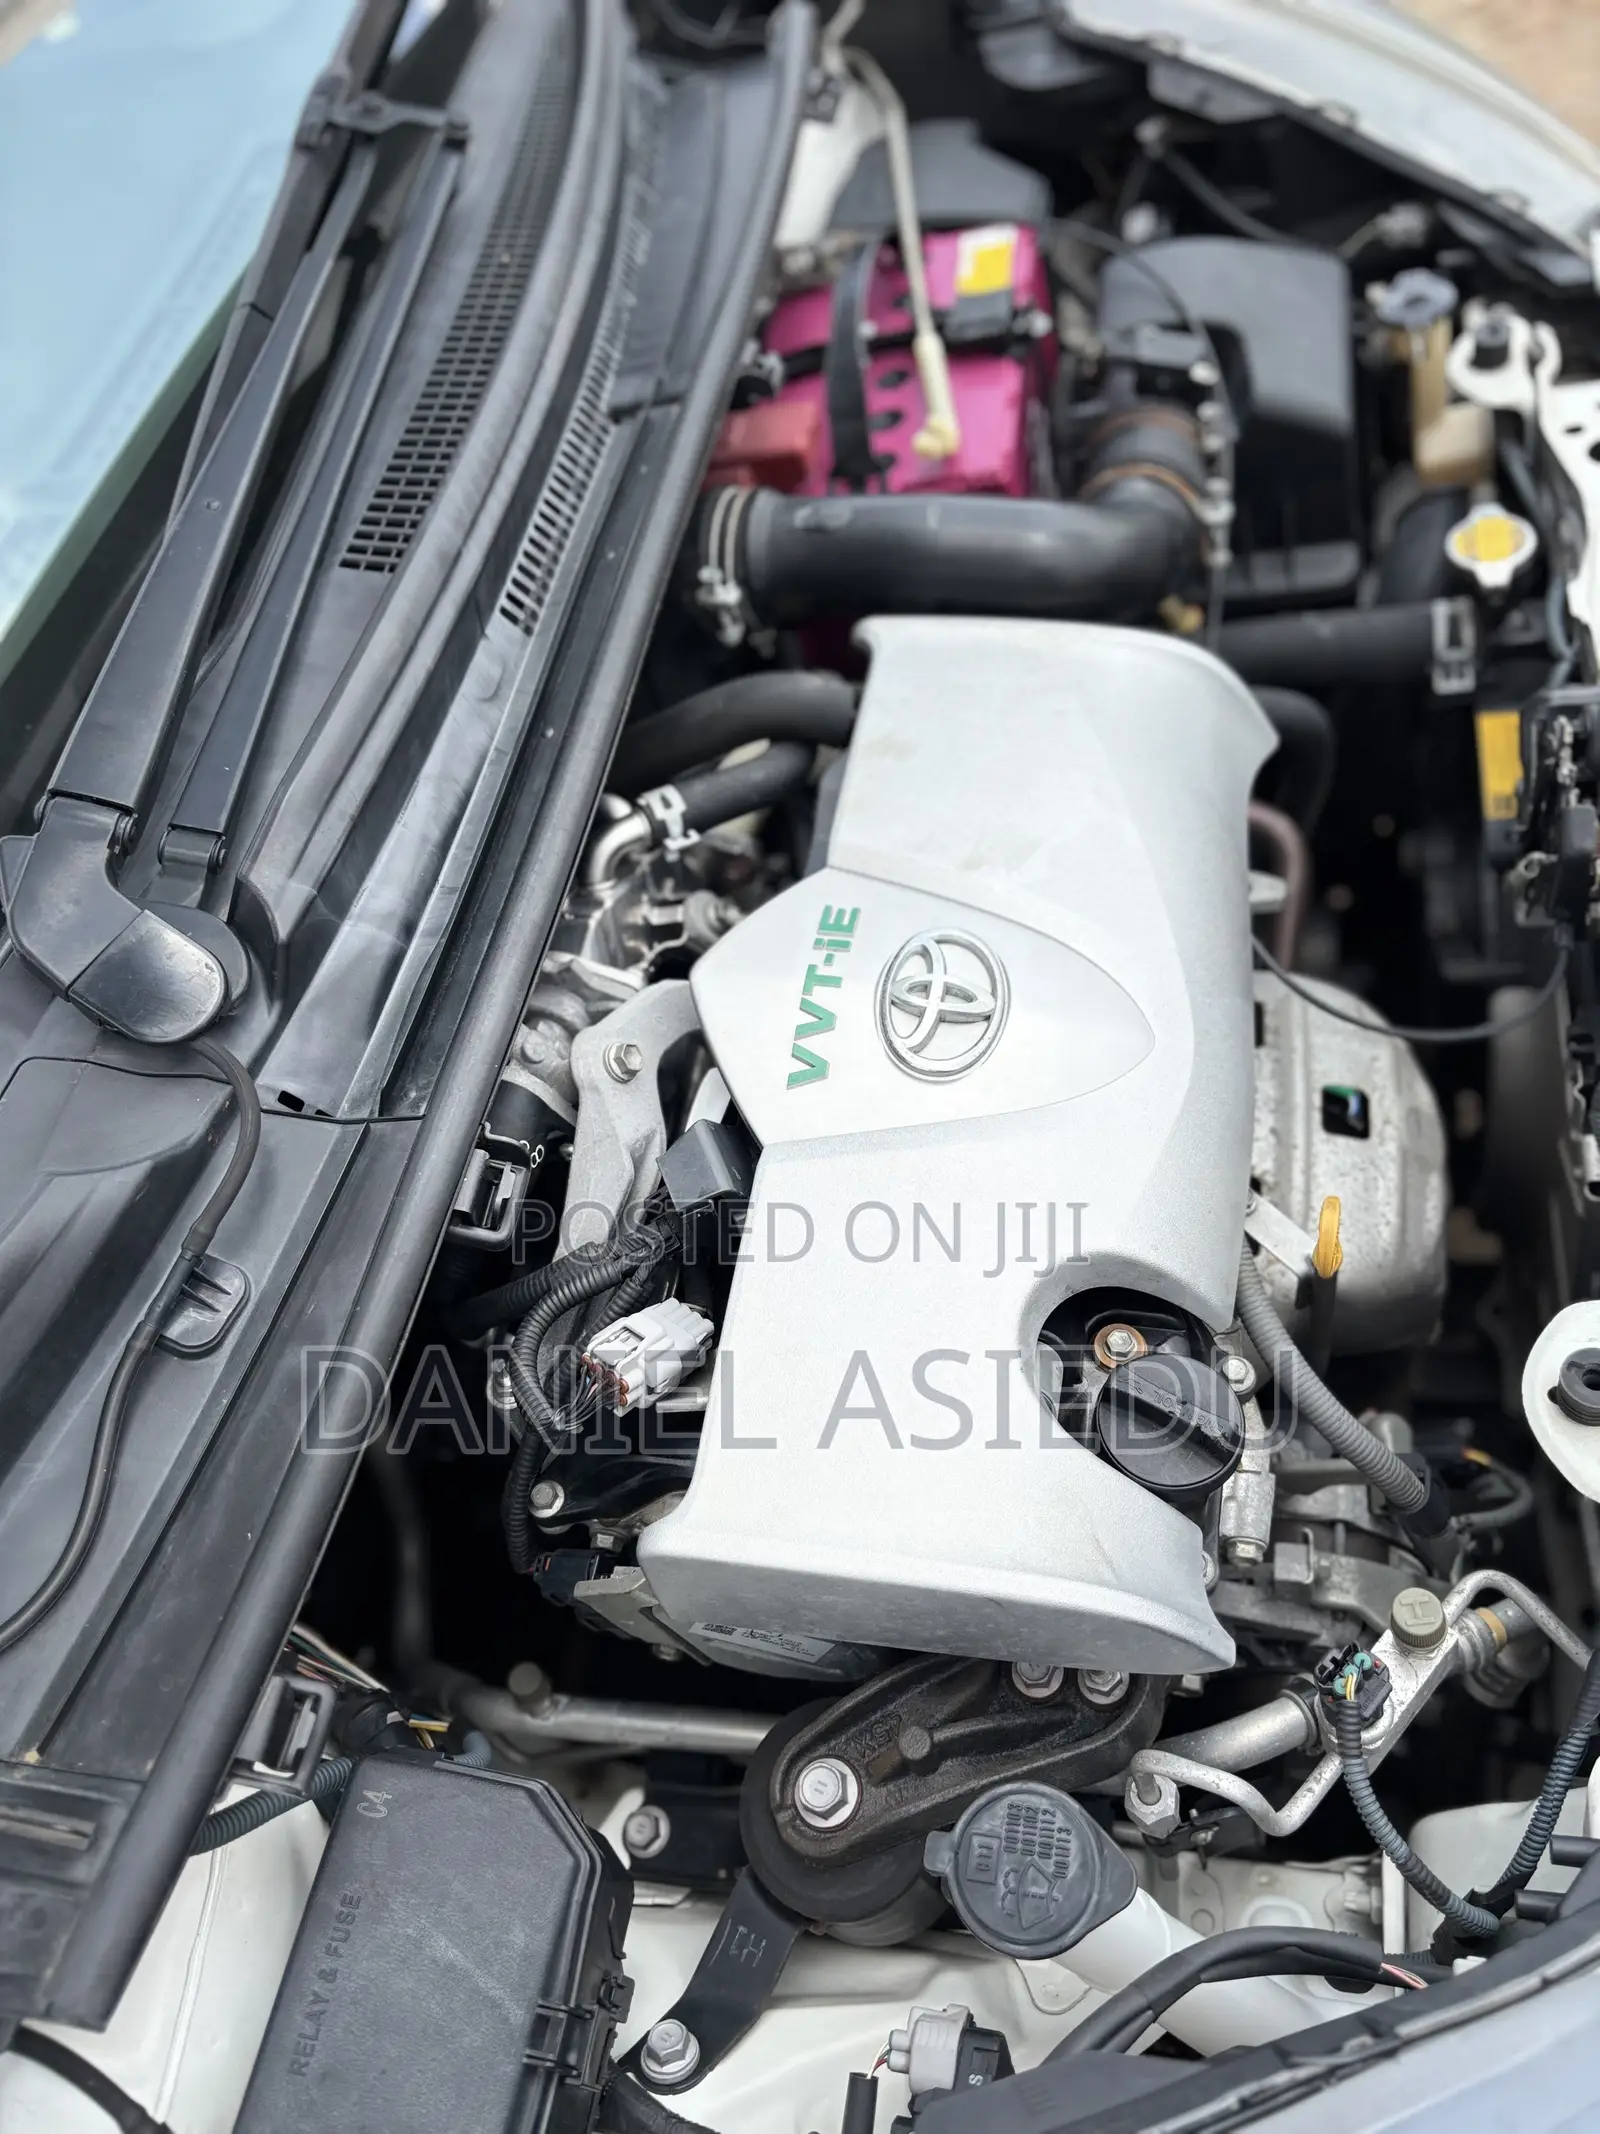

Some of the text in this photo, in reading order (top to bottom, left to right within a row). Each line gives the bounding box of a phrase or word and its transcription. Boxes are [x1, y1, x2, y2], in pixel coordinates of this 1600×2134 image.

[786, 904, 862, 1091] VVT-iE
[1152, 1390, 1173, 1409] OIL
[356, 1789, 393, 1818] C4
[288, 1892, 362, 2077] RELAY & FUSE
